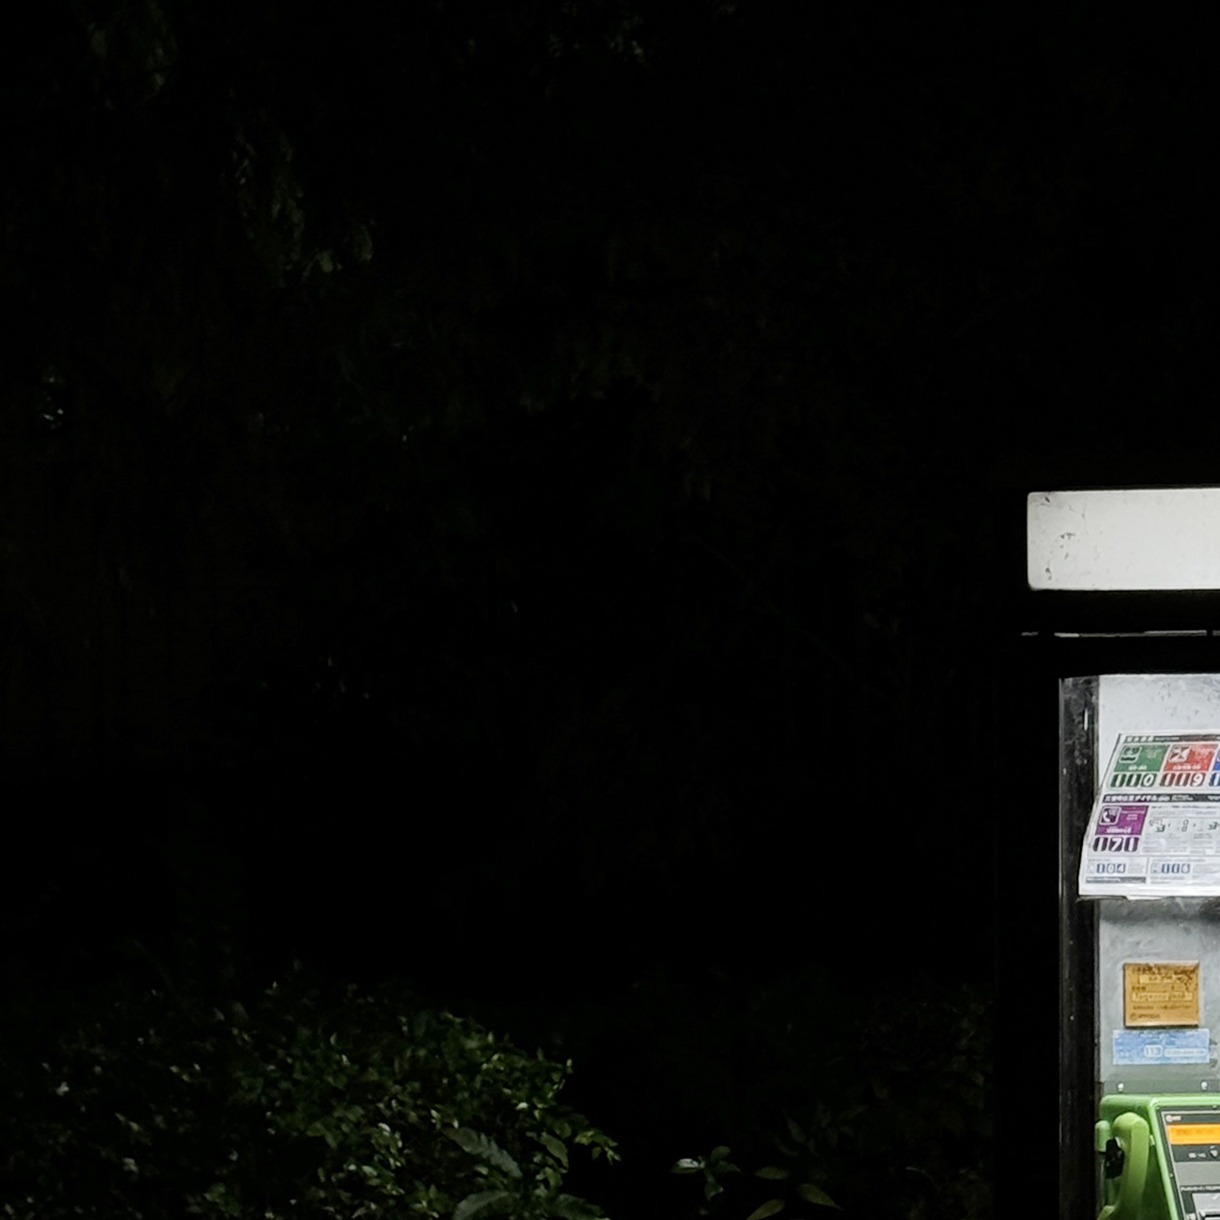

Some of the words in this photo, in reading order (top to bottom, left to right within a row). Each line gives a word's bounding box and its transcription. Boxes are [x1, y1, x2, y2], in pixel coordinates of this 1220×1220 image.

[1113, 772, 1157, 787] 110
[1162, 772, 1206, 787] 119
[1095, 836, 1138, 853] 171
